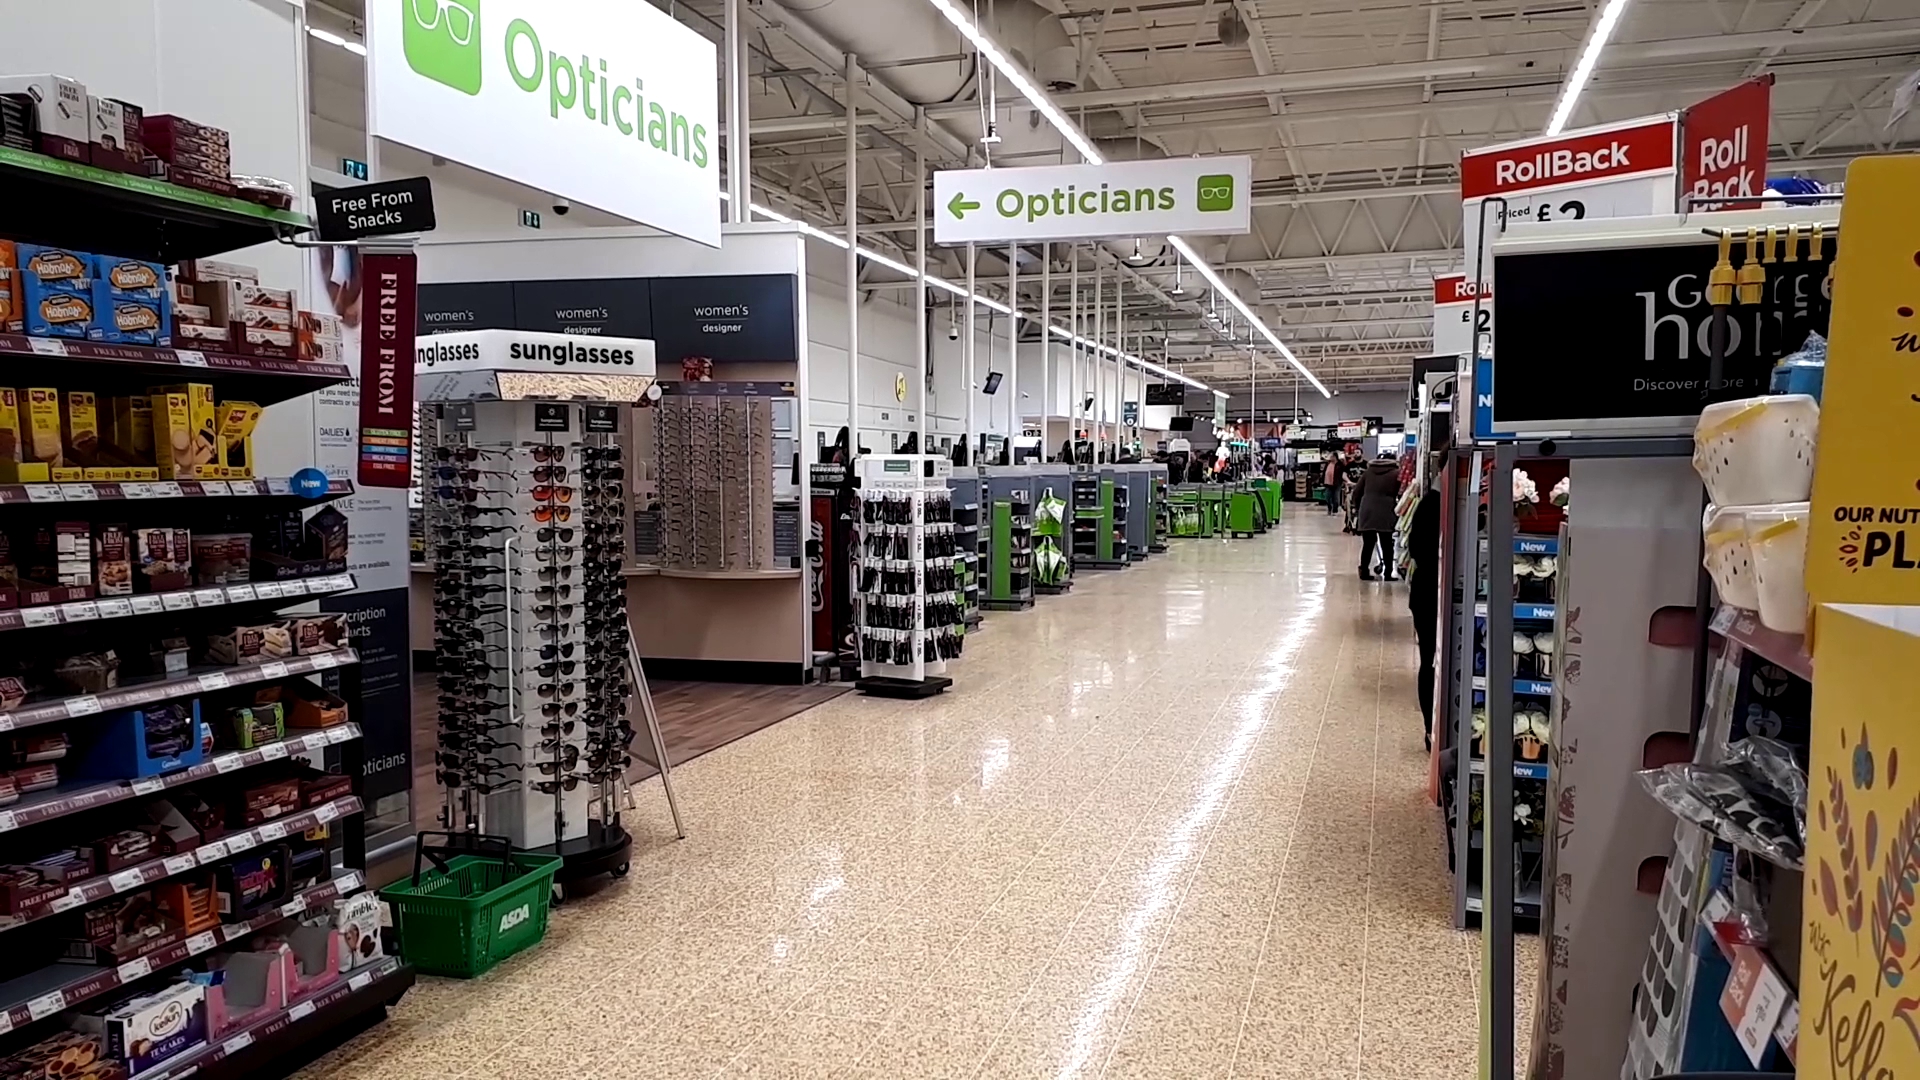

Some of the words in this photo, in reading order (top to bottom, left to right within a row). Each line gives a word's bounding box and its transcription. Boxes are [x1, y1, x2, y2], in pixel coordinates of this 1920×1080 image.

[504, 18, 708, 169] Opticians
[1700, 124, 1748, 175] Roll
[1496, 142, 1630, 185] RollBack
[1692, 166, 1755, 213] Back
[332, 198, 367, 214] Free
[371, 191, 413, 208] From
[996, 183, 1175, 223] Opticians
[348, 210, 402, 230] Snacks
[36, 262, 75, 275] Hobnobs
[117, 272, 149, 284] Hobnobs
[45, 305, 82, 318] Hobnobs
[380, 273, 398, 340] FREE
[424, 310, 474, 322] women's
[555, 307, 608, 320] women's
[694, 304, 749, 316] women's
[116, 314, 150, 326] Hobnobs
[702, 324, 742, 334] designer
[563, 326, 602, 335] designer
[415, 342, 479, 366] nglasses
[510, 341, 635, 366] sunglasses
[378, 348, 396, 415] FROM
[1634, 378, 1699, 391] Discover
[1705, 378, 1744, 388] ore
[1478, 394, 1492, 407] N
[301, 479, 321, 488] New
[1834, 506, 1875, 523] OUR
[1521, 542, 1546, 551] New
[1863, 530, 1920, 569] PL
[347, 607, 386, 623] cription
[347, 625, 372, 637] ucts
[20, 896, 42, 909] FREE
[42, 887, 65, 901] FROM
[499, 903, 530, 932] ASDA
[153, 1009, 181, 1032] kelkin
[1813, 959, 1894, 1080] Kell
[150, 1036, 186, 1058] TEACAKES
